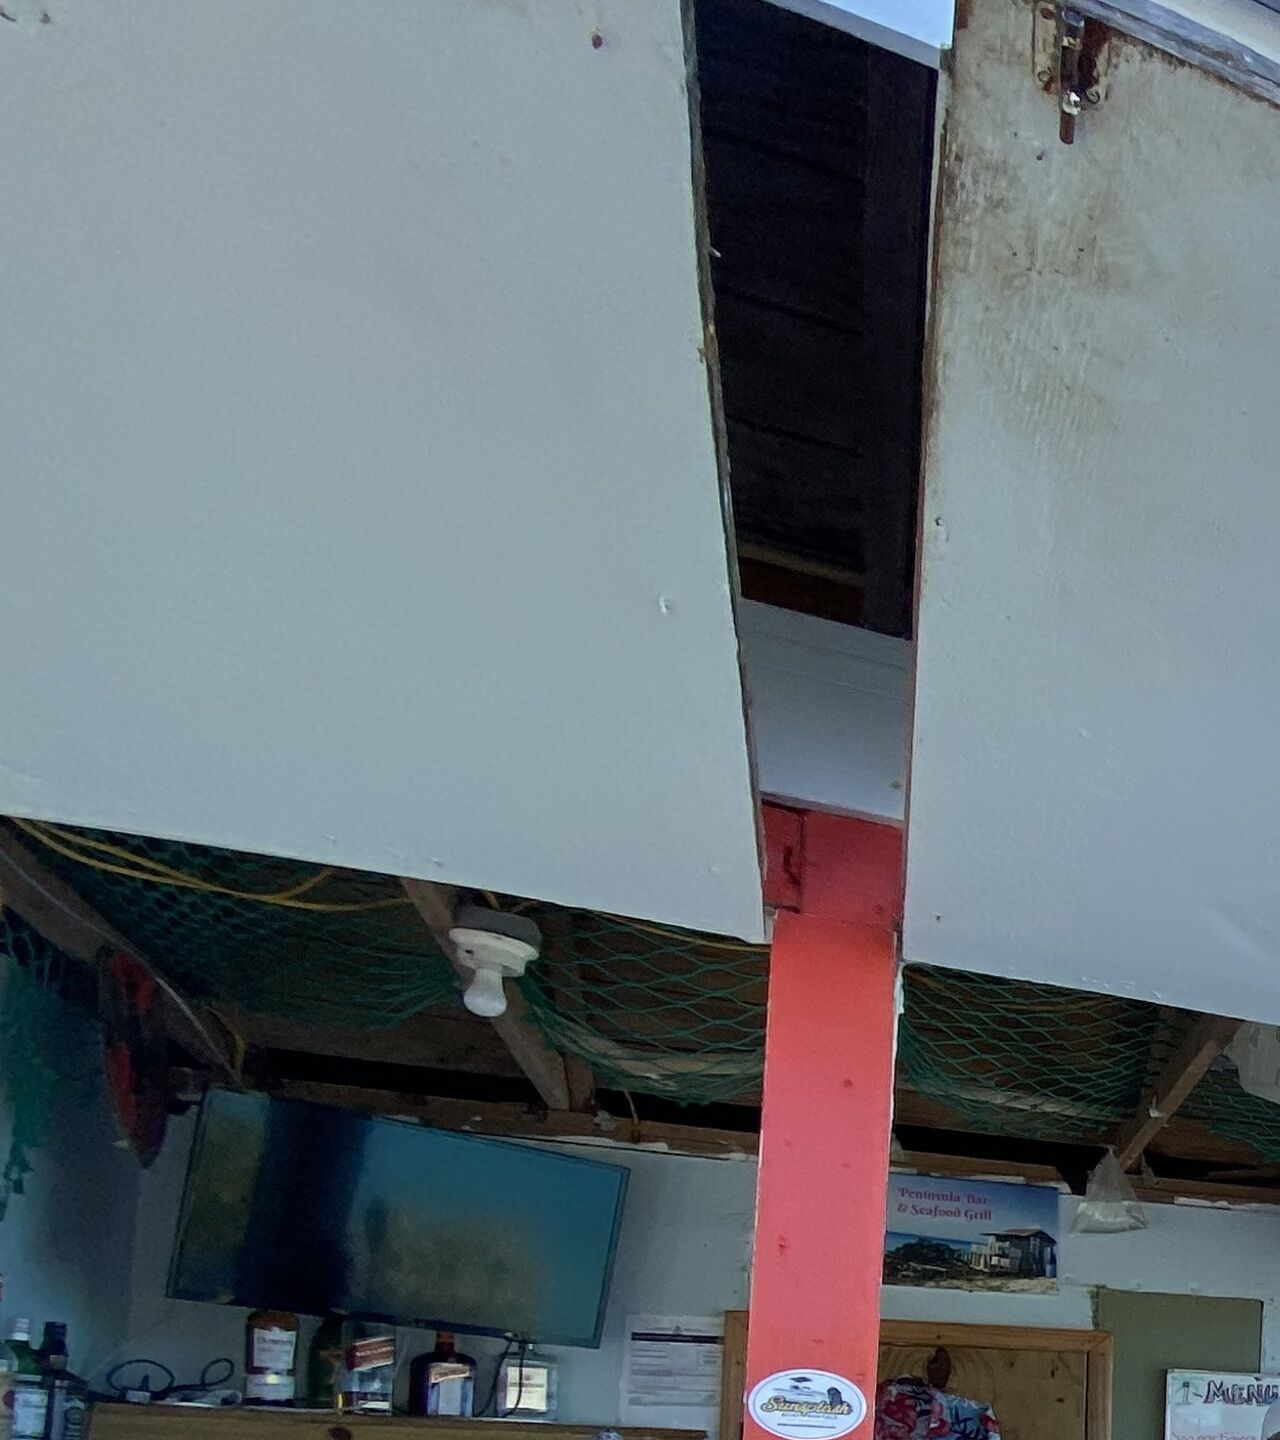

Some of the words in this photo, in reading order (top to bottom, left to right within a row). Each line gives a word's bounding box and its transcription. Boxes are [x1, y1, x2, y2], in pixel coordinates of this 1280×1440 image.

[898, 1187, 961, 1202] Peninsula
[964, 1193, 988, 1205] Bar
[897, 1203, 908, 1214] &
[910, 1204, 961, 1219] Seafood
[964, 1209, 992, 1221] Grill
[761, 1395, 853, 1417] Sunsplash
